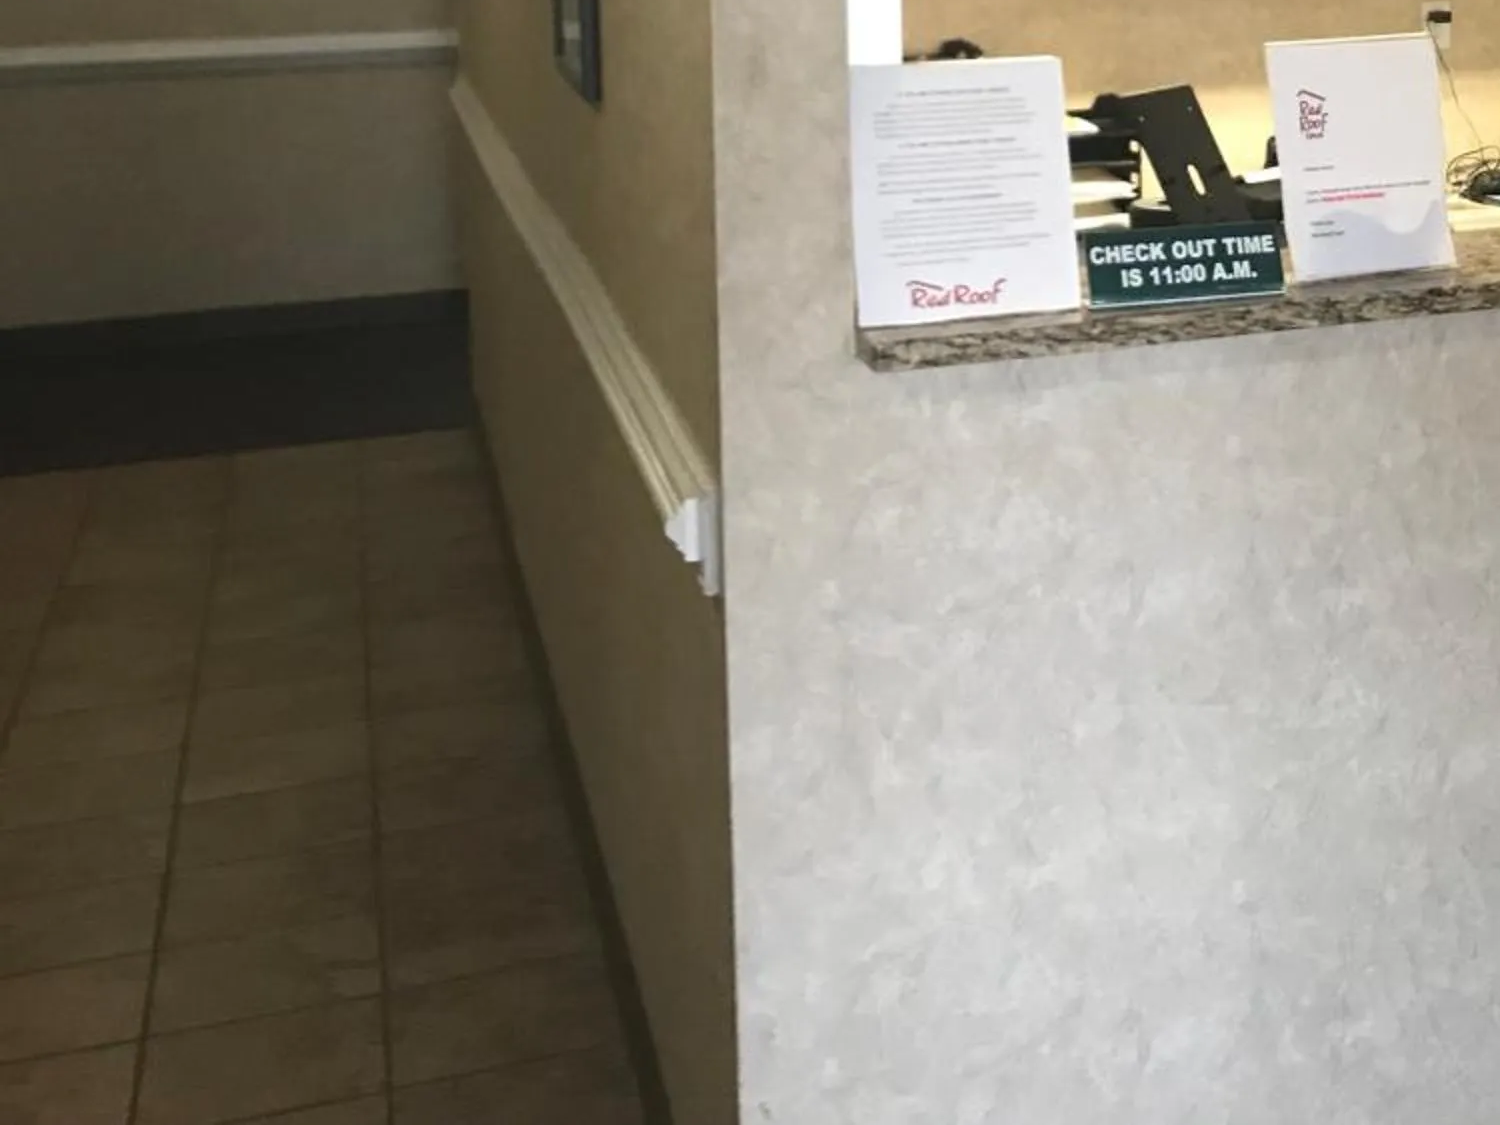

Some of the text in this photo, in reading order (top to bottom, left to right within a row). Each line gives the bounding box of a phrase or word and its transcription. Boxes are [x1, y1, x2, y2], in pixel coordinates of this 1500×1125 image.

[1089, 235, 1275, 265] CHECK OUT TIME
[1120, 260, 1259, 288] IS 11:00 A.M.
[954, 278, 1008, 304] Roof
